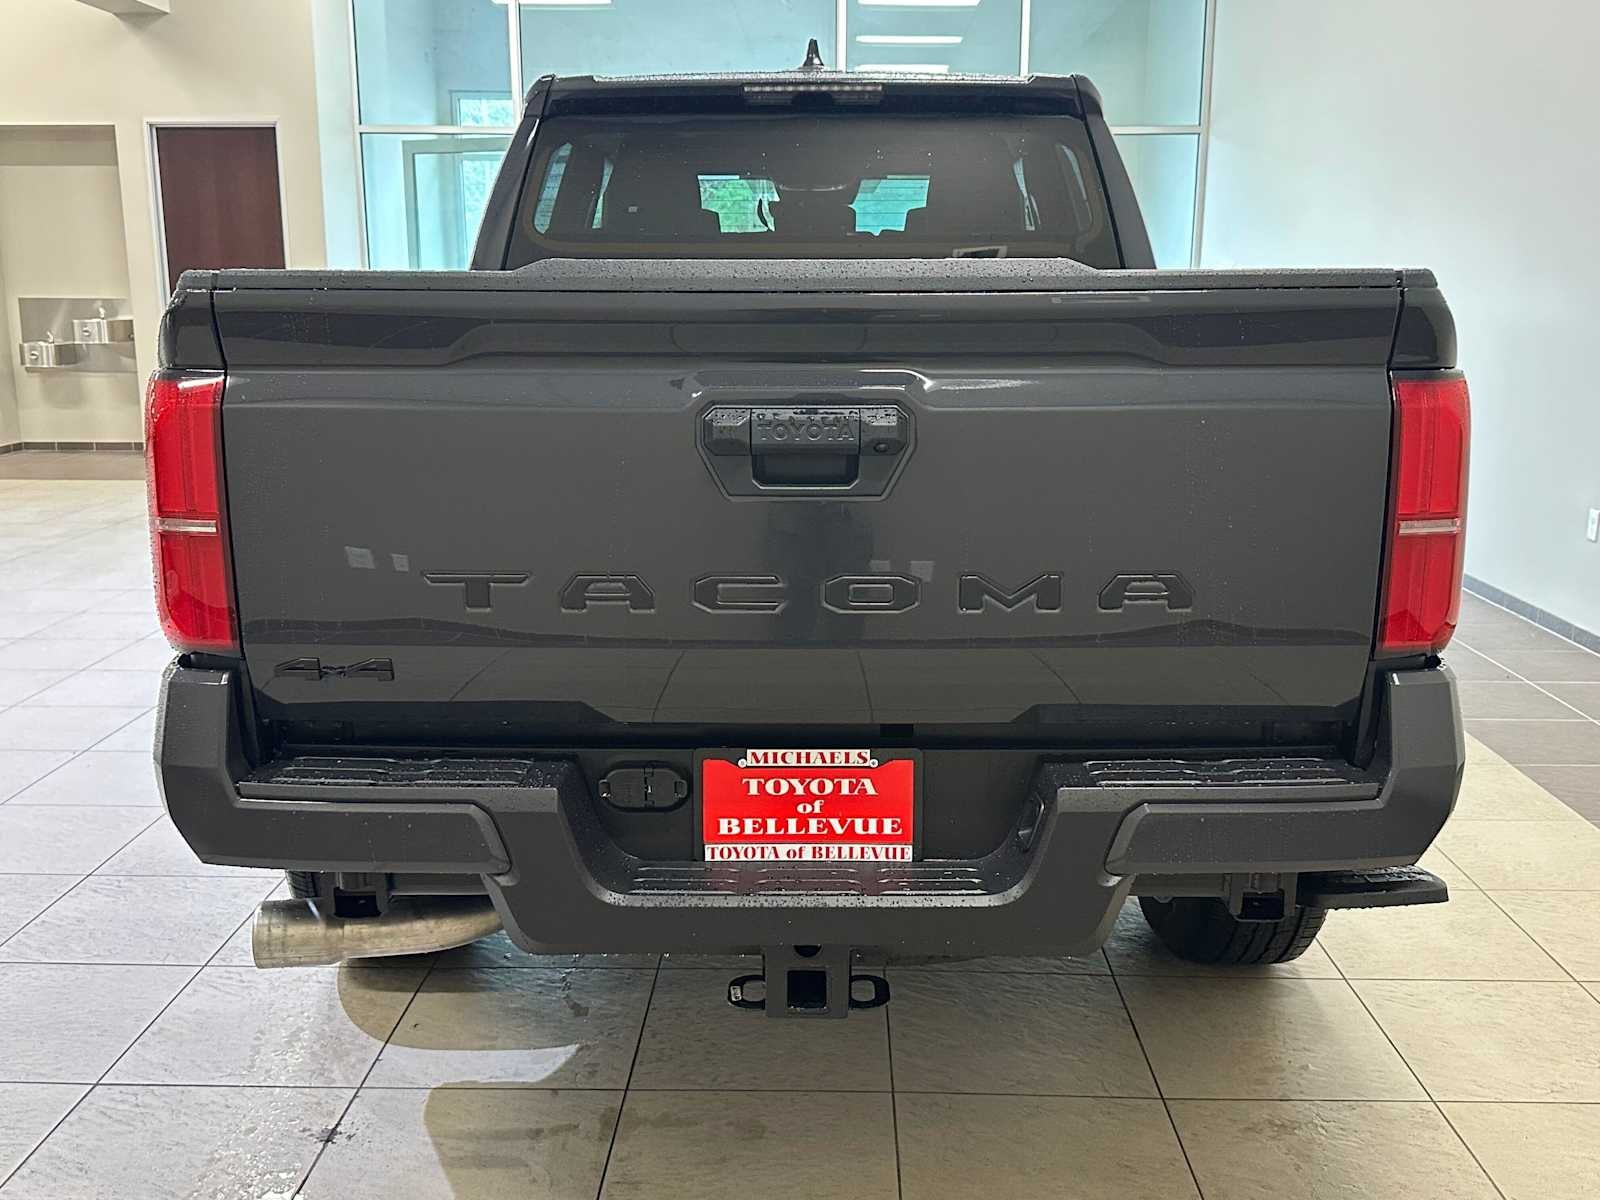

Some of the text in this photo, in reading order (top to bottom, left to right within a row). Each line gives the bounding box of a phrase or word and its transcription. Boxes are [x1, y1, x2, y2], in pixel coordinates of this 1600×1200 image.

[756, 422, 856, 441] TOYOTA
[423, 571, 1194, 614] TACOMA
[749, 751, 869, 765] MICHAELS
[742, 778, 878, 796] TOYOTA
[796, 799, 825, 814] of
[717, 817, 903, 835] BELLEVUE
[706, 846, 911, 860] TOYOTA of BELLEVUE
